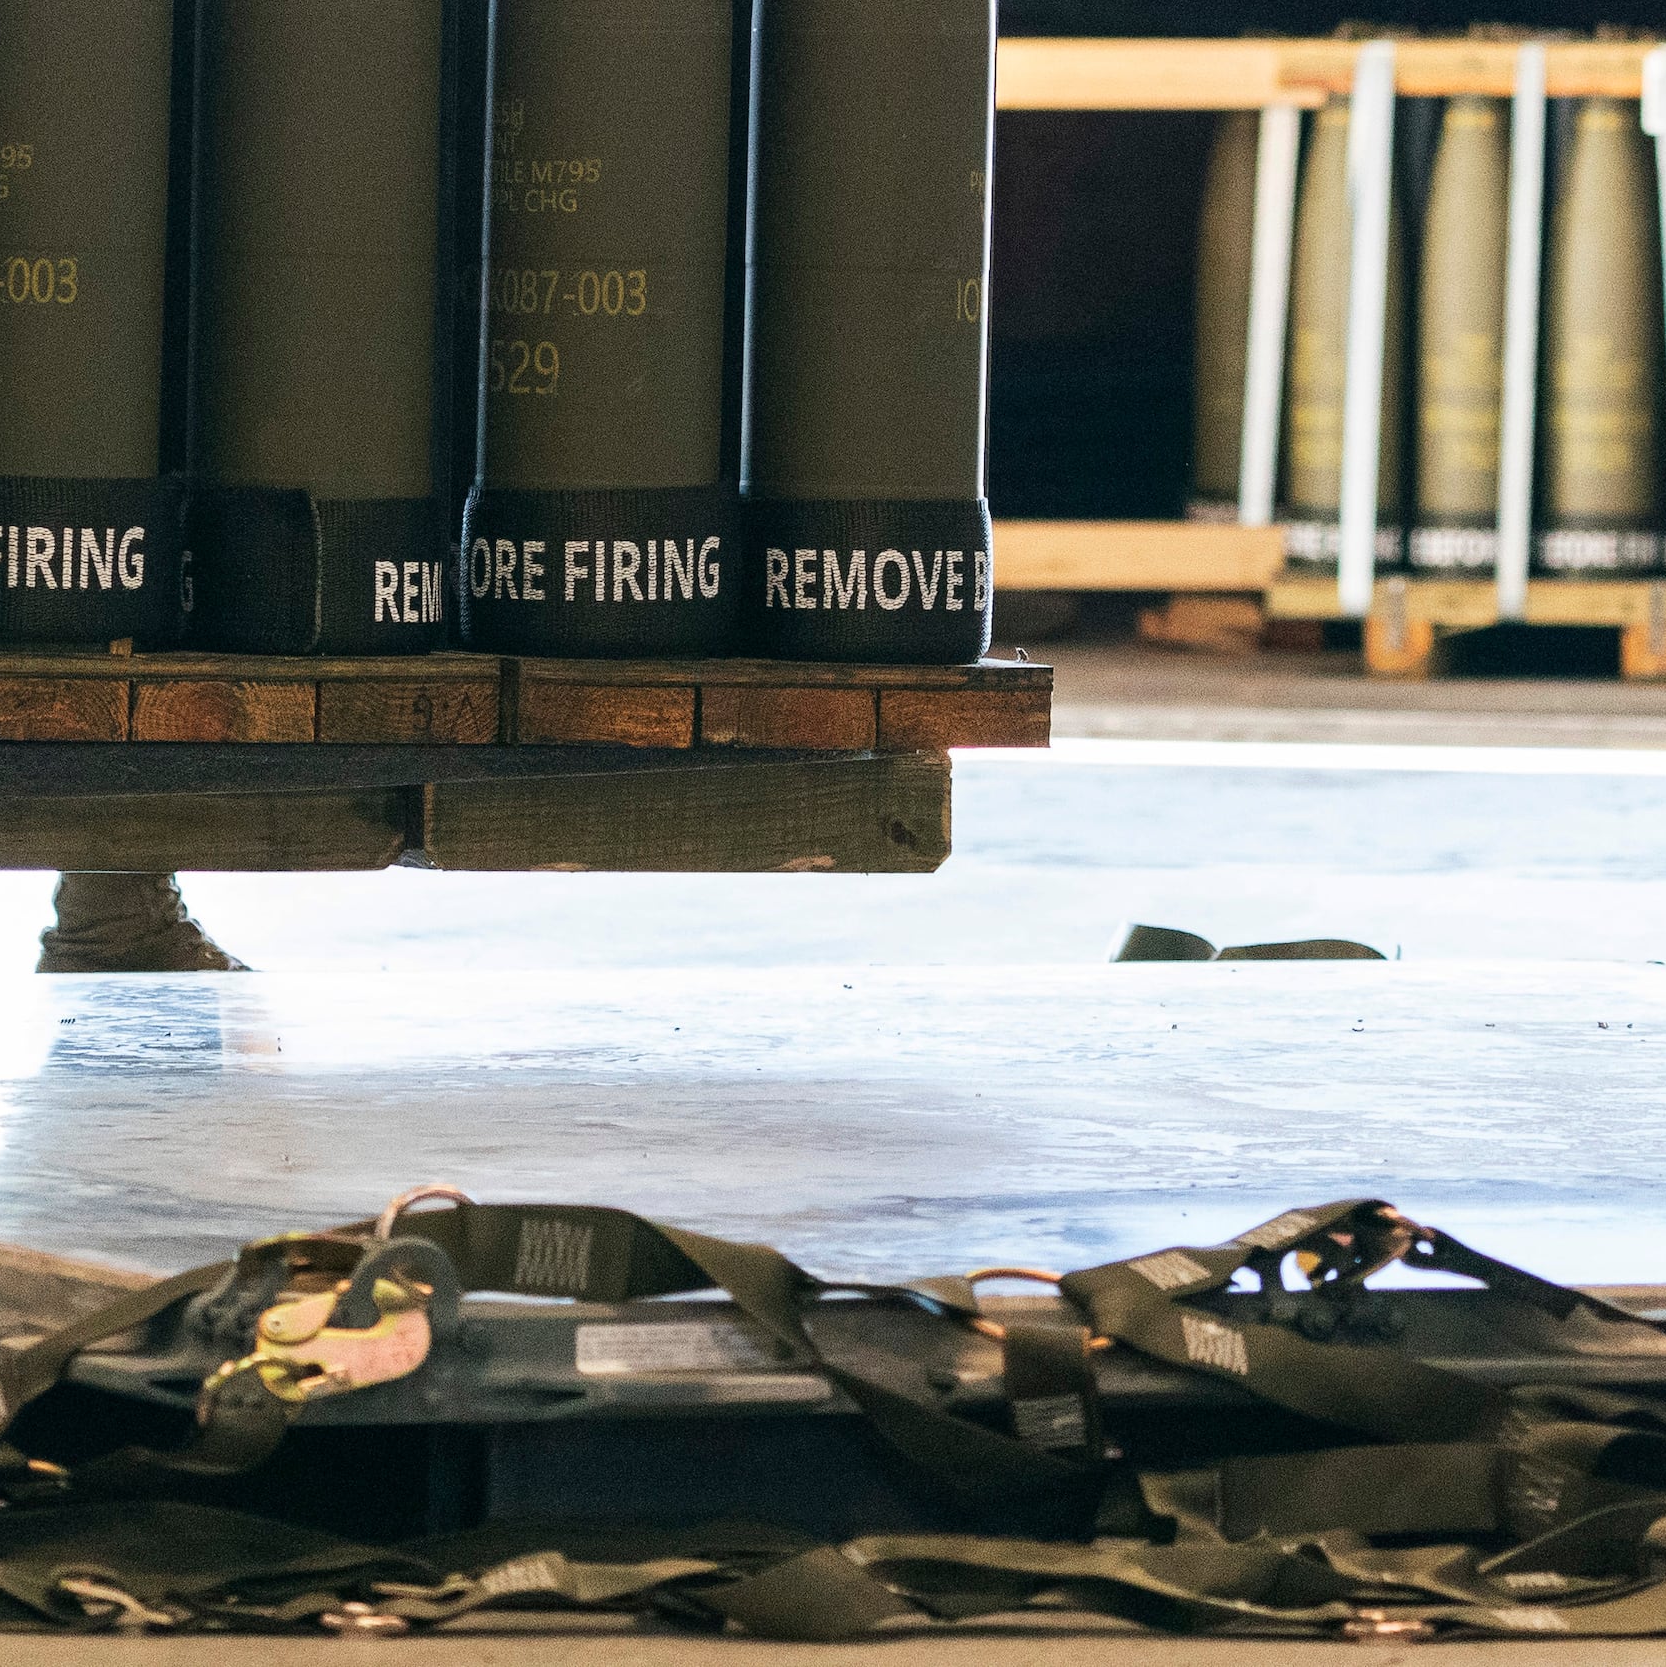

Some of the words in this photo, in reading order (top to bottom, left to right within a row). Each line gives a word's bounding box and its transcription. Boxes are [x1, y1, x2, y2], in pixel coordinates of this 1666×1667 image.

[530, 159, 602, 184] M795
[524, 188, 578, 213] CHG
[564, 536, 722, 603] FIRING
[764, 547, 964, 612] REMOVE
